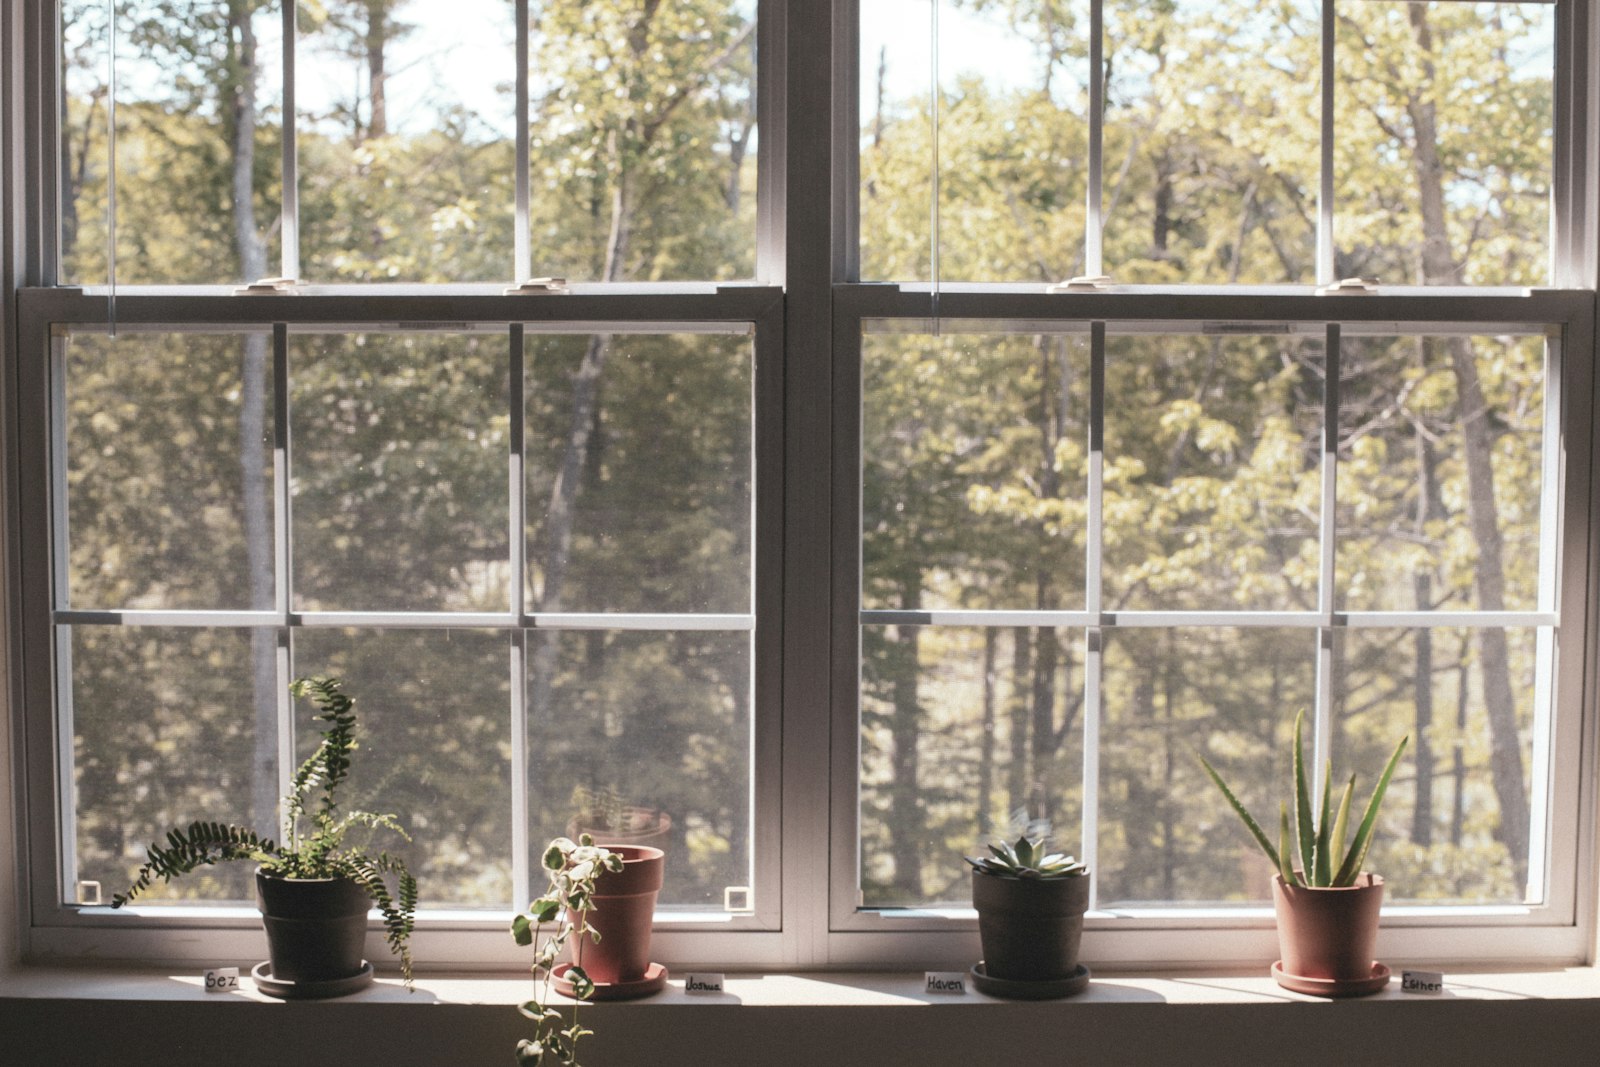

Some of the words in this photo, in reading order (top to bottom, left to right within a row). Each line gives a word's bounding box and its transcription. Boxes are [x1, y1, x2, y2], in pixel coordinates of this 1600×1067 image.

[206, 972, 237, 988] Sez
[928, 976, 962, 990] Haven
[1402, 973, 1442, 991] Esther
